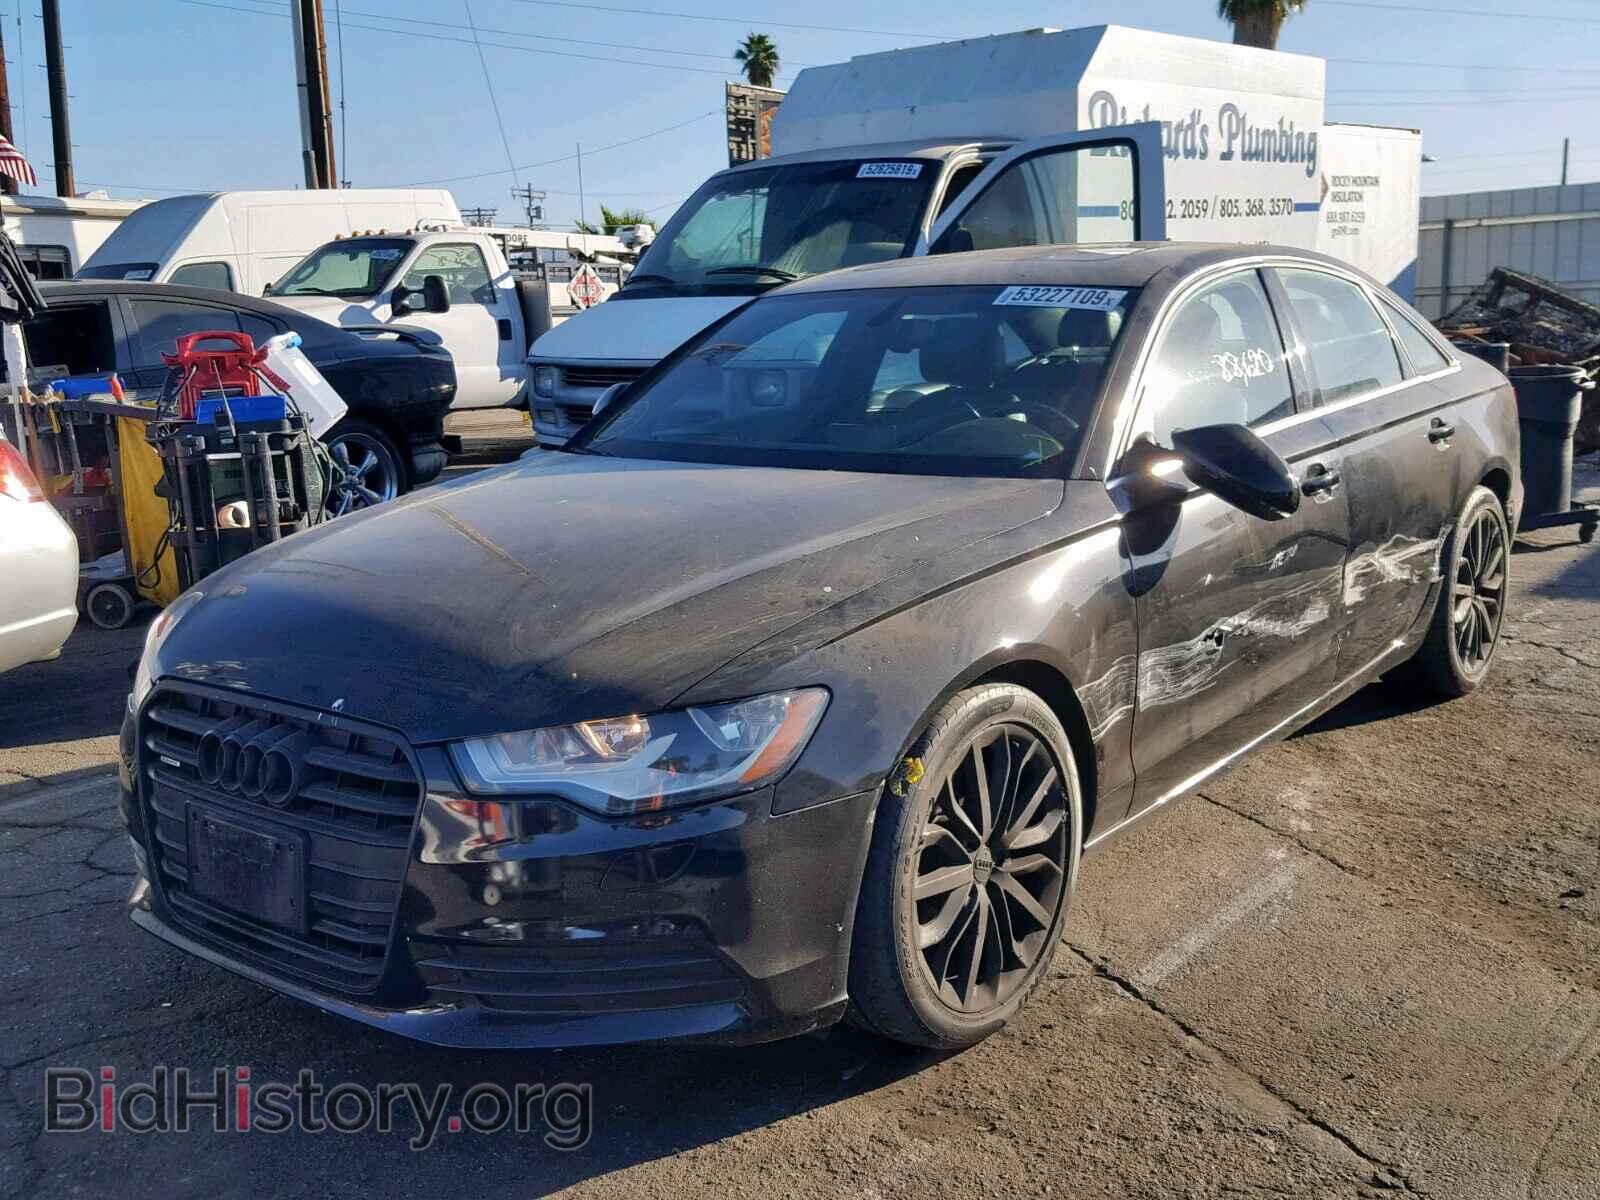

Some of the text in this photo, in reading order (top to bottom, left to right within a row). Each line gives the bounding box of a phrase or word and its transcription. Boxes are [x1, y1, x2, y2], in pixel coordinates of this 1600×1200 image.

[1218, 102, 1317, 178] Plumbing
[1180, 199, 1209, 219] 2059
[1219, 199, 1242, 218] 805.
[1245, 198, 1267, 217] 368.
[1269, 198, 1294, 216] 3570
[1011, 287, 1109, 306] 53227109
